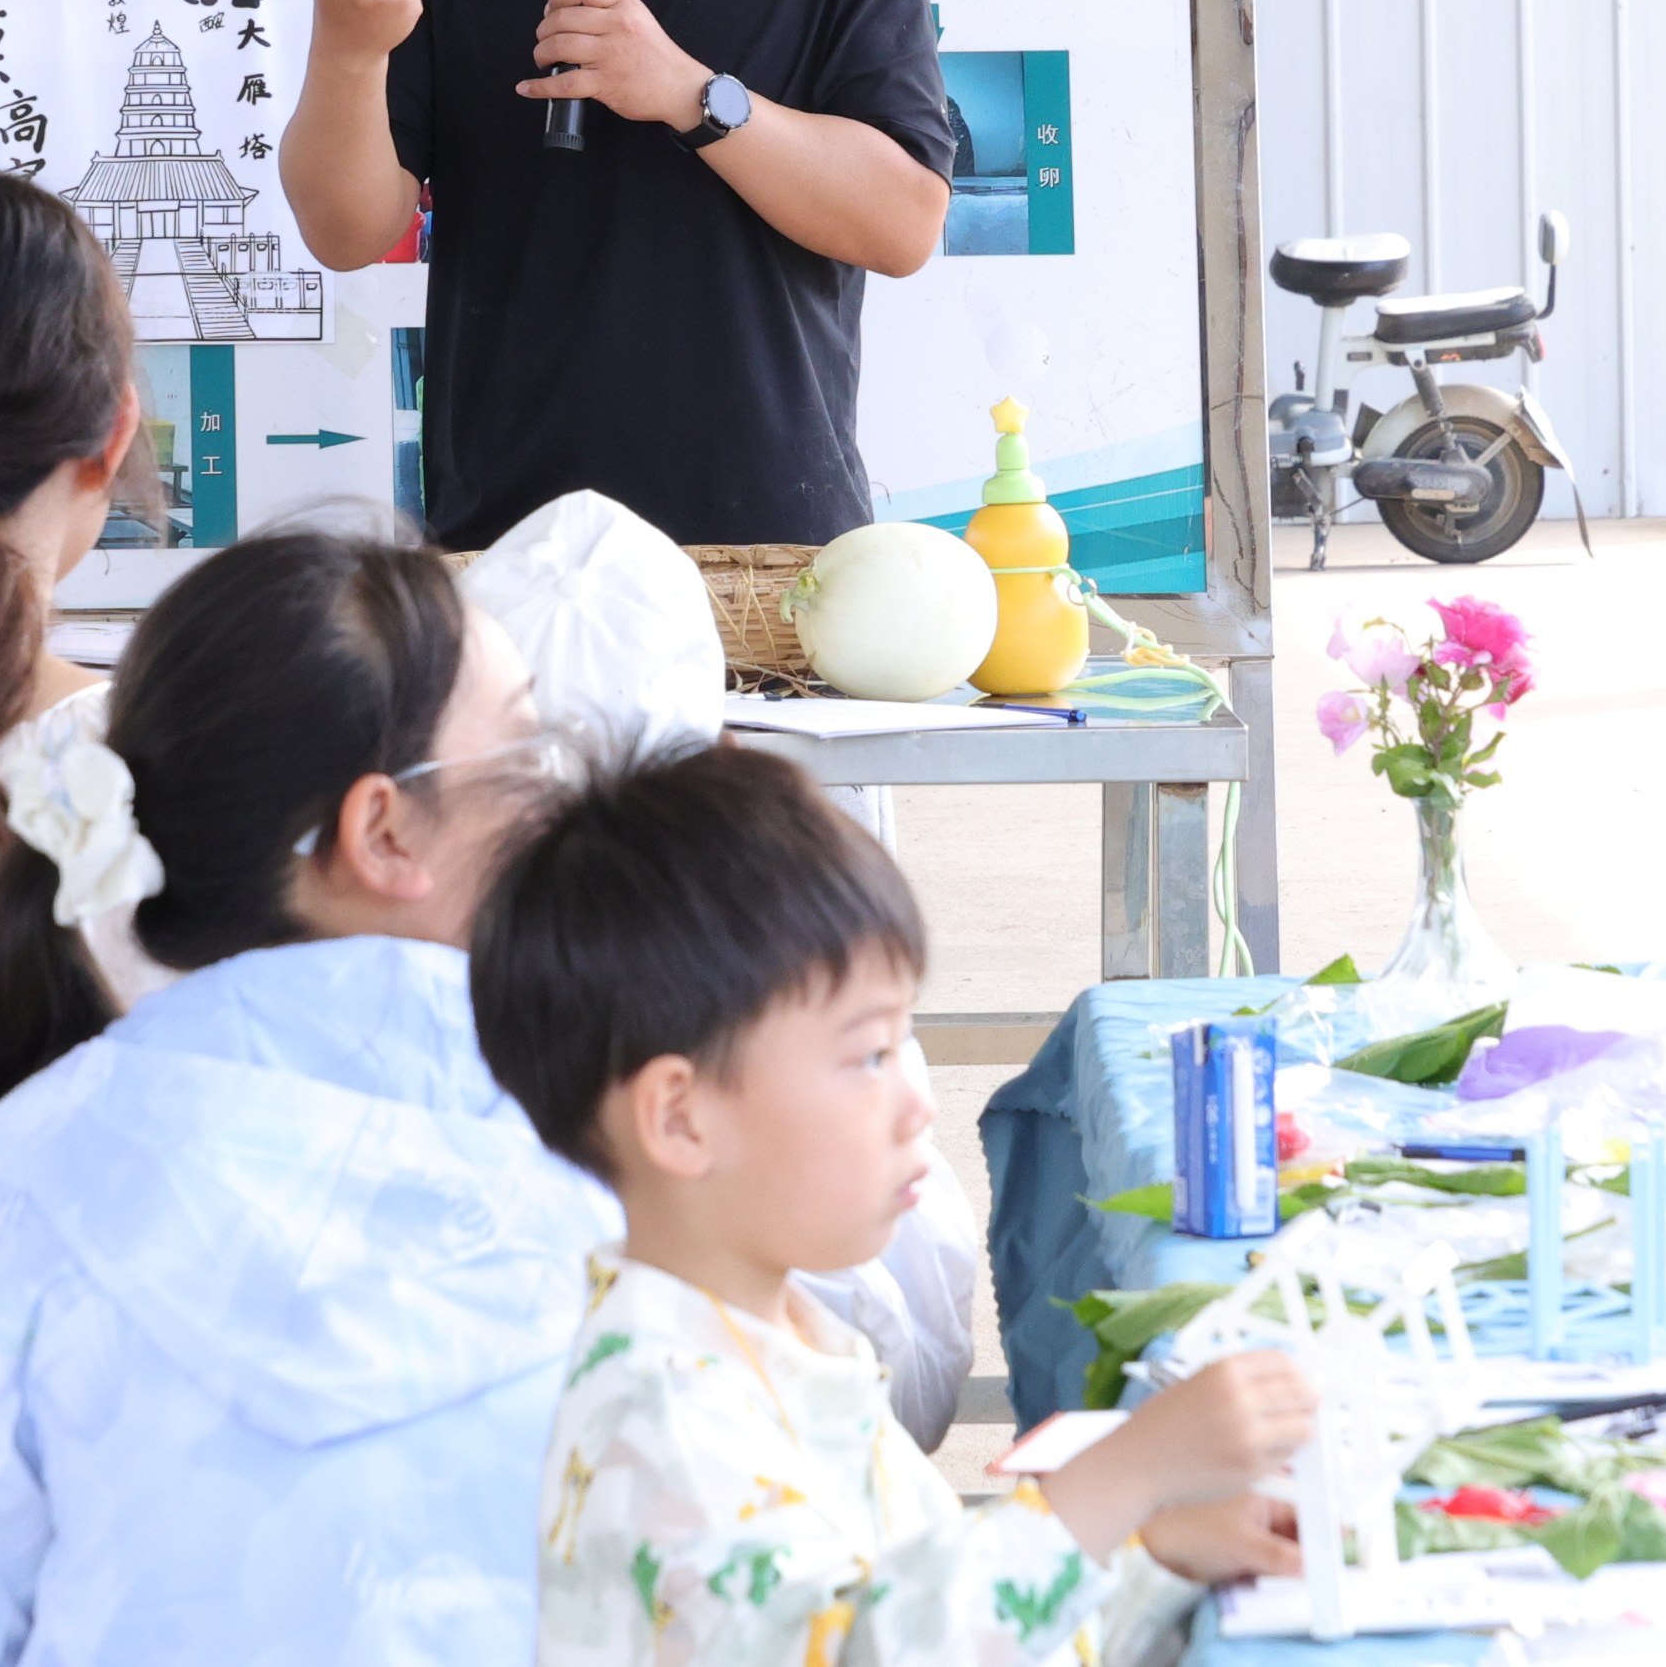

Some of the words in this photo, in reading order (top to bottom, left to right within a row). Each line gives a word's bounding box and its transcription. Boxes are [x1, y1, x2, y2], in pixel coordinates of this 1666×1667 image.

[199, 15, 225, 33] 西安
[235, 17, 274, 161] 大雁塔
[1037, 123, 1060, 188] 收卵
[200, 411, 223, 475] 加工
